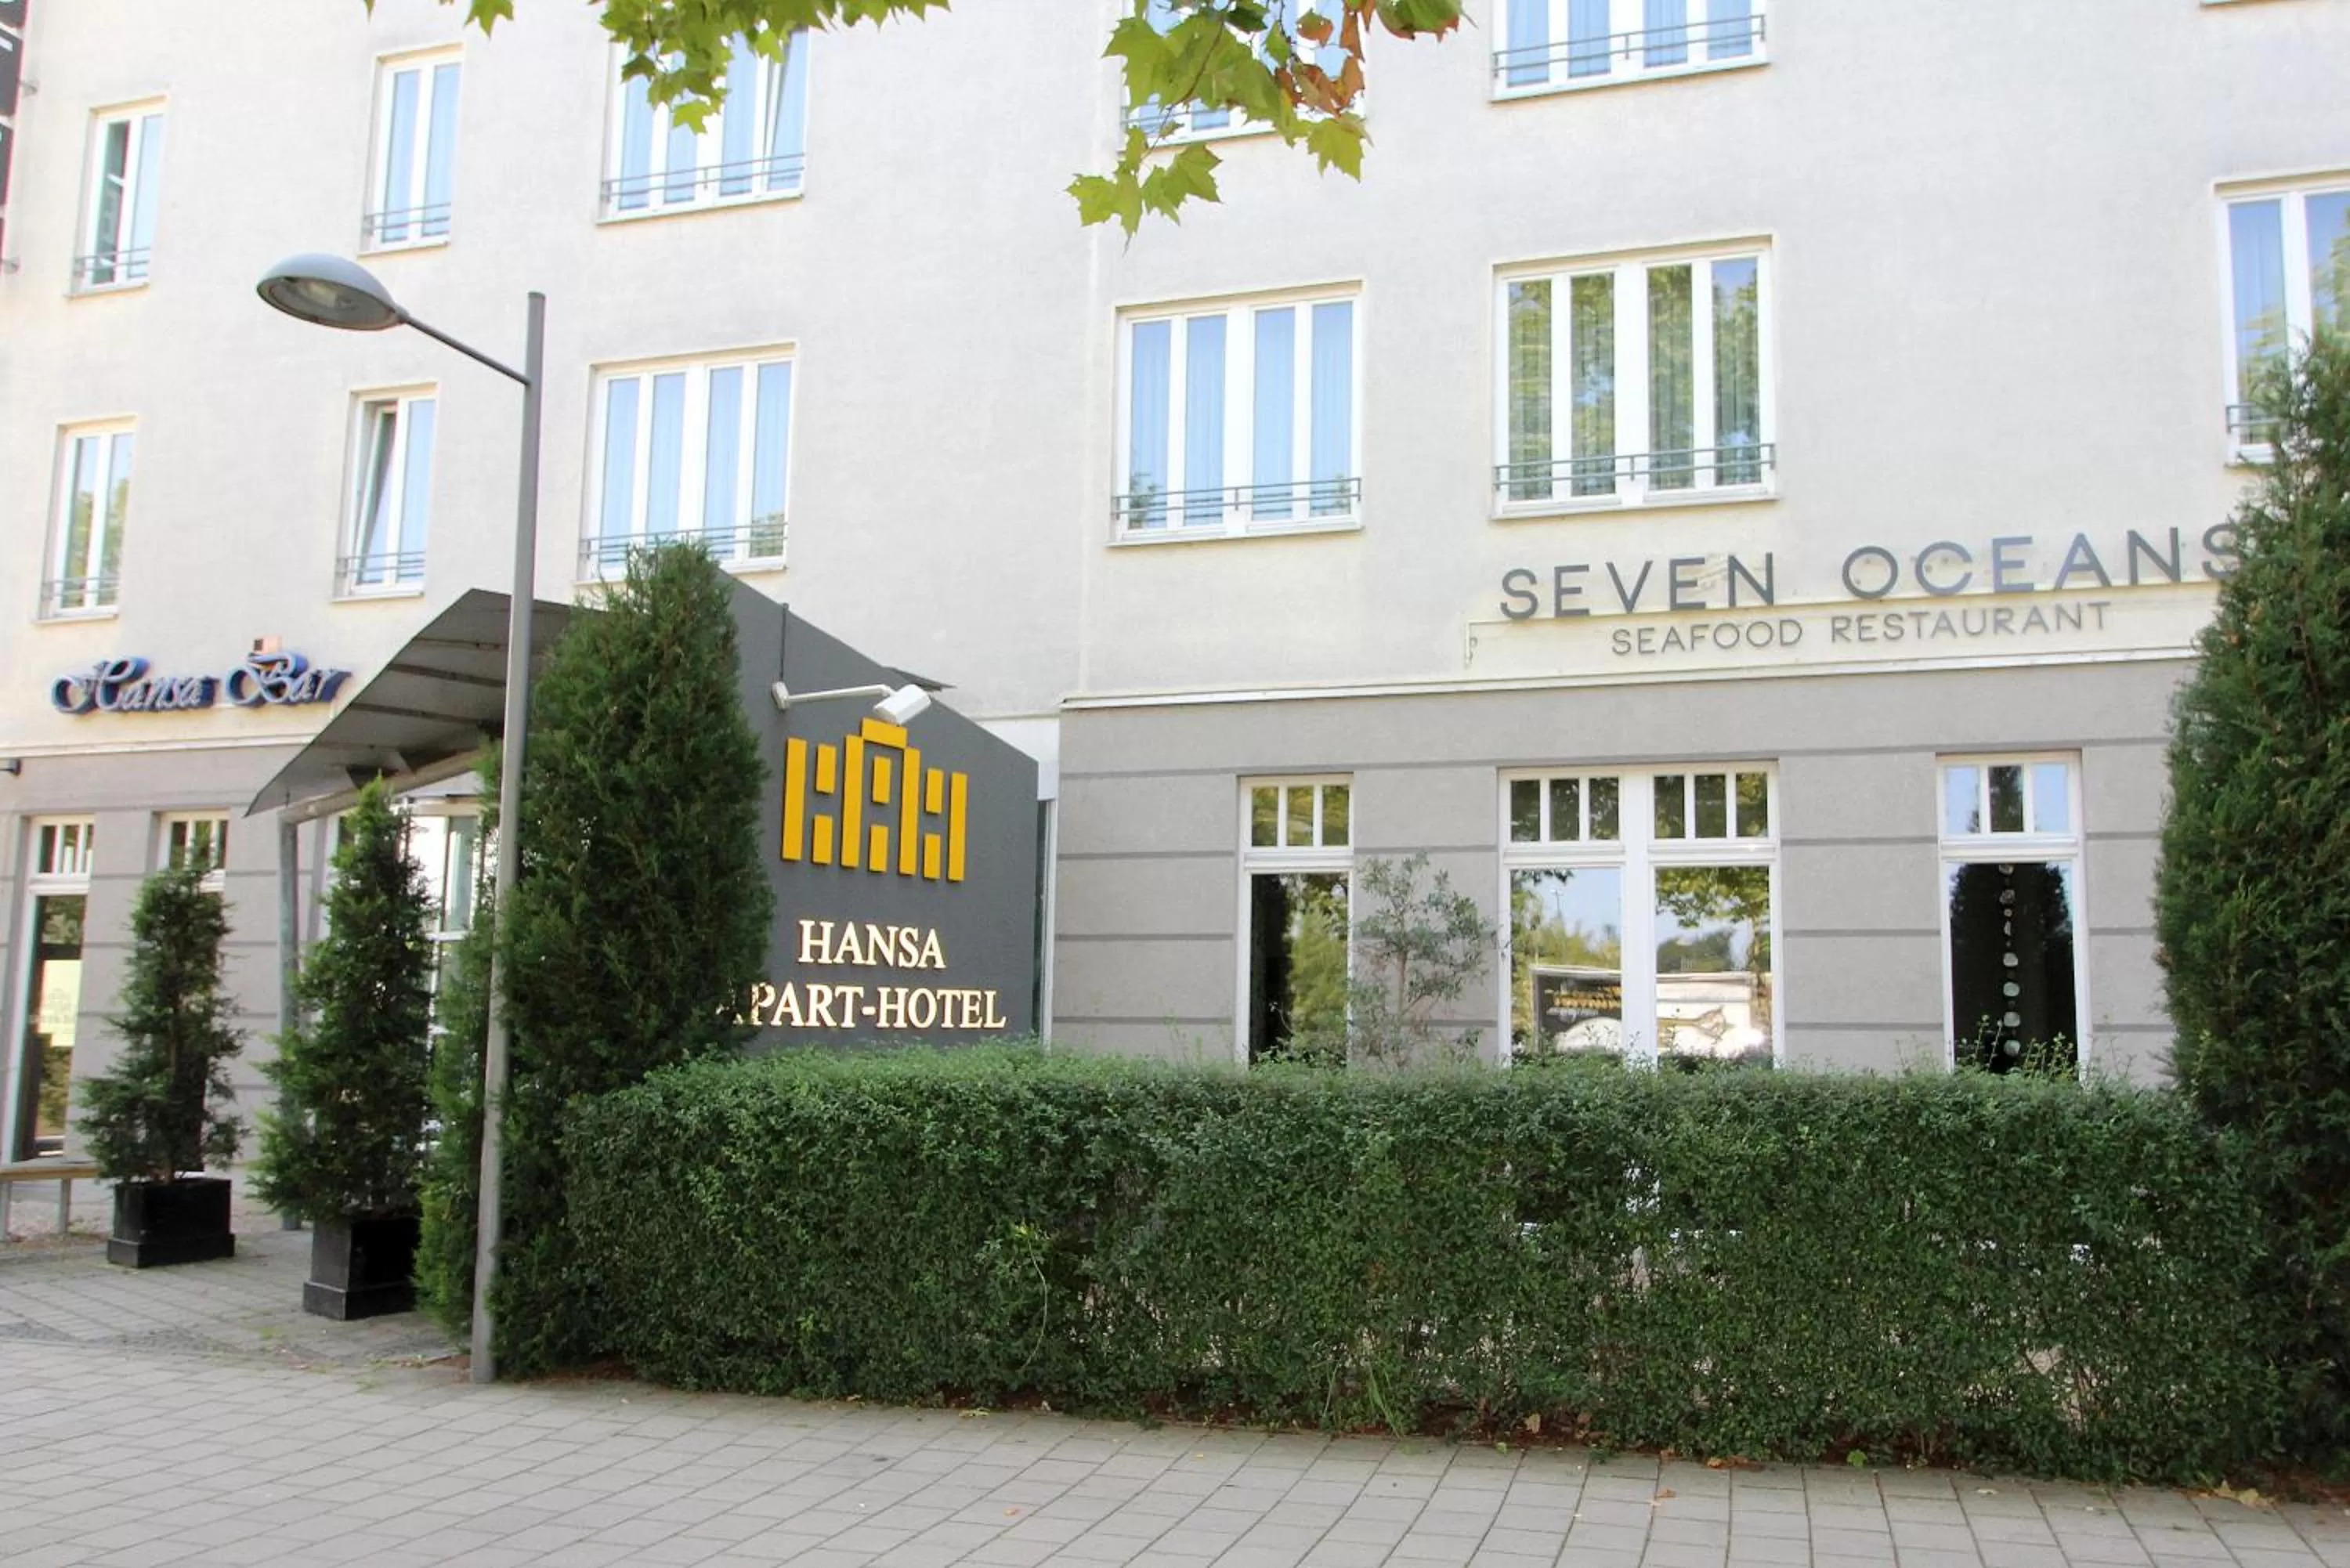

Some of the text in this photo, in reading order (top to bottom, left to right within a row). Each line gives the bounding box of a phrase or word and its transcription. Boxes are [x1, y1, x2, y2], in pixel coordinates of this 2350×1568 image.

[1499, 522, 2237, 620] SEVEN OCEANS
[1611, 602, 2112, 656] SEAFOOD RESTAURANT
[225, 651, 352, 707] Bar
[797, 919, 947, 970] HANSA
[715, 980, 1007, 1029] PART-HOTEL
